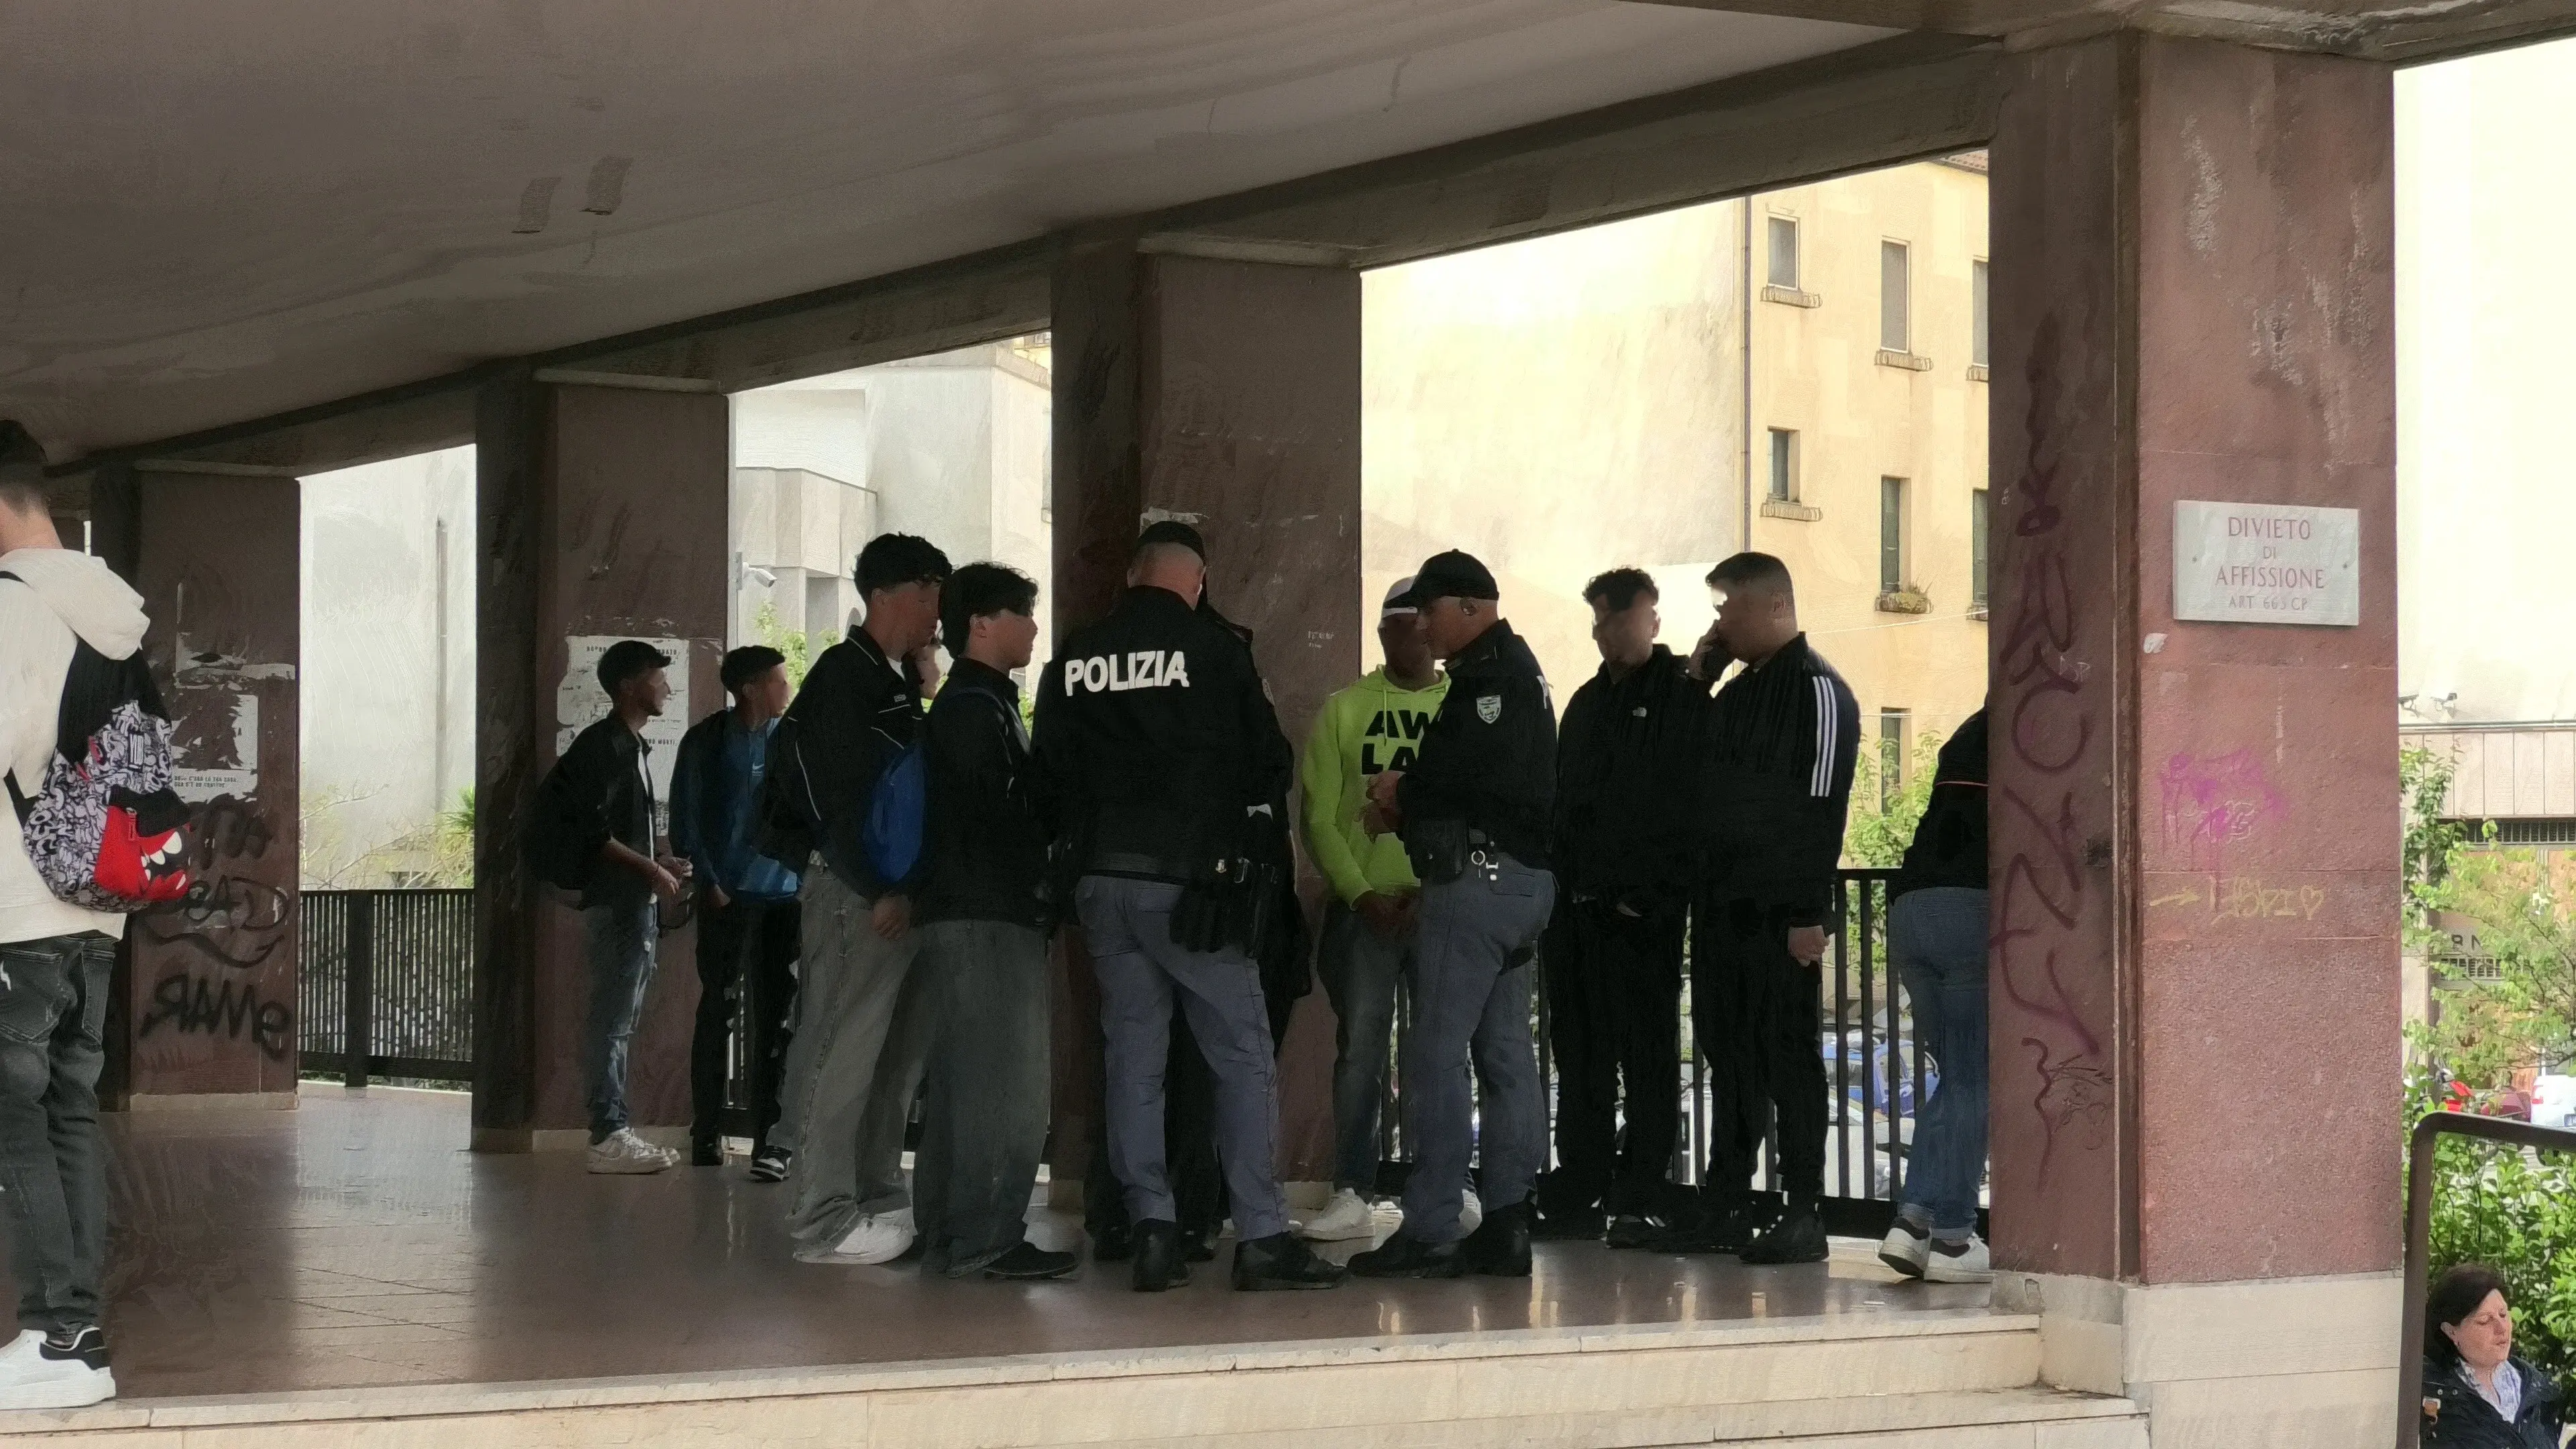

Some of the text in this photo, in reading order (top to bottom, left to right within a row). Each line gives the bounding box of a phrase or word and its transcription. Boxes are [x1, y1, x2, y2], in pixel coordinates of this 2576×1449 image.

[2228, 517, 2310, 540] DIVIETO
[2263, 545, 2276, 559] DI
[2216, 566, 2325, 588] AFFISSIONE
[2228, 595, 2255, 609] ART
[1065, 650, 1190, 697] POLIZIA
